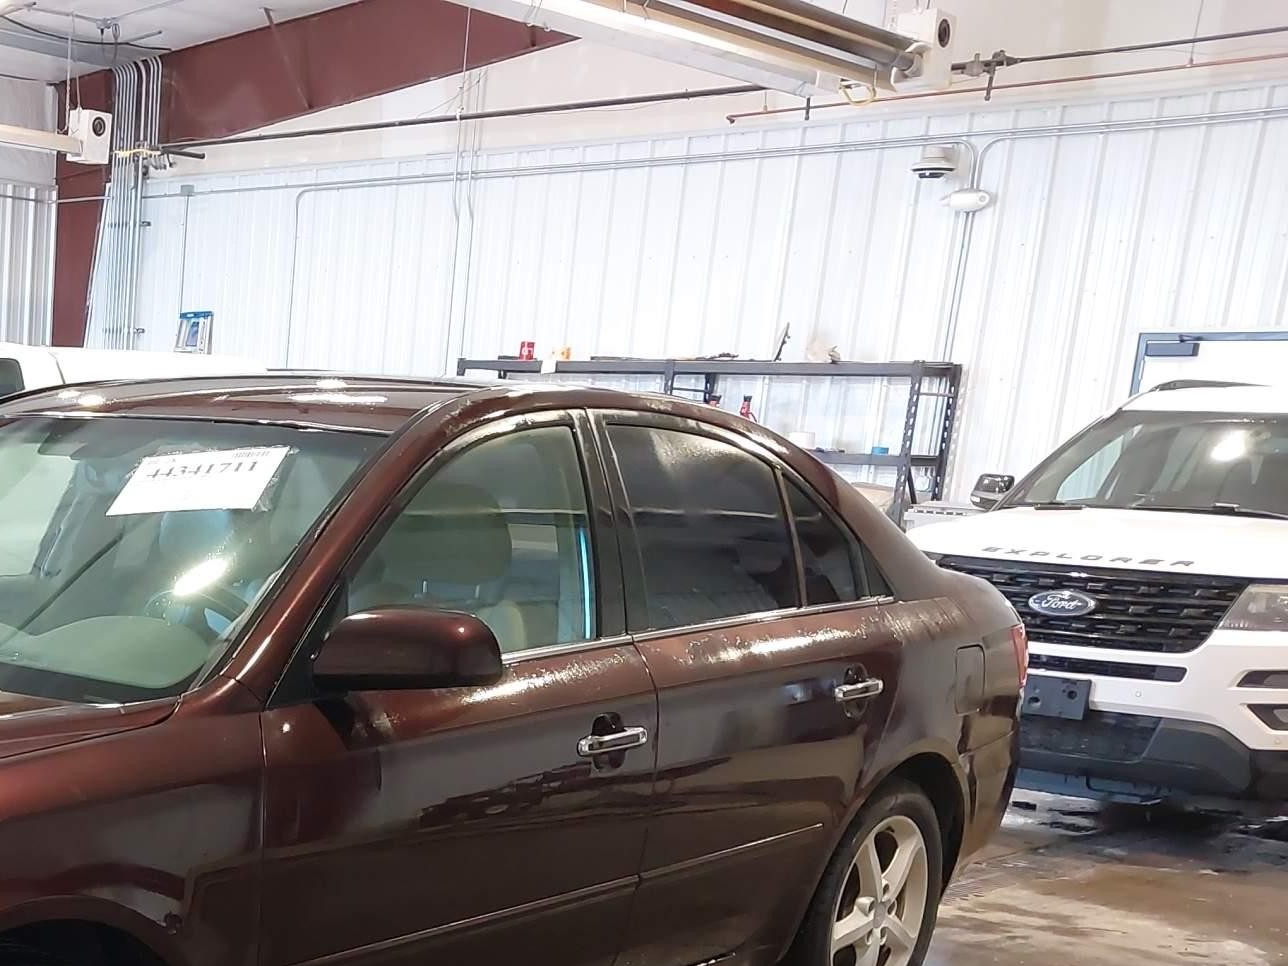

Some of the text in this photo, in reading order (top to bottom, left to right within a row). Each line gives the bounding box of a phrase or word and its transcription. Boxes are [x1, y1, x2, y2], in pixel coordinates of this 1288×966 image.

[145, 461, 259, 479] 44341711
[981, 546, 1195, 567] EXPLORER
[1040, 591, 1082, 610] Ford
